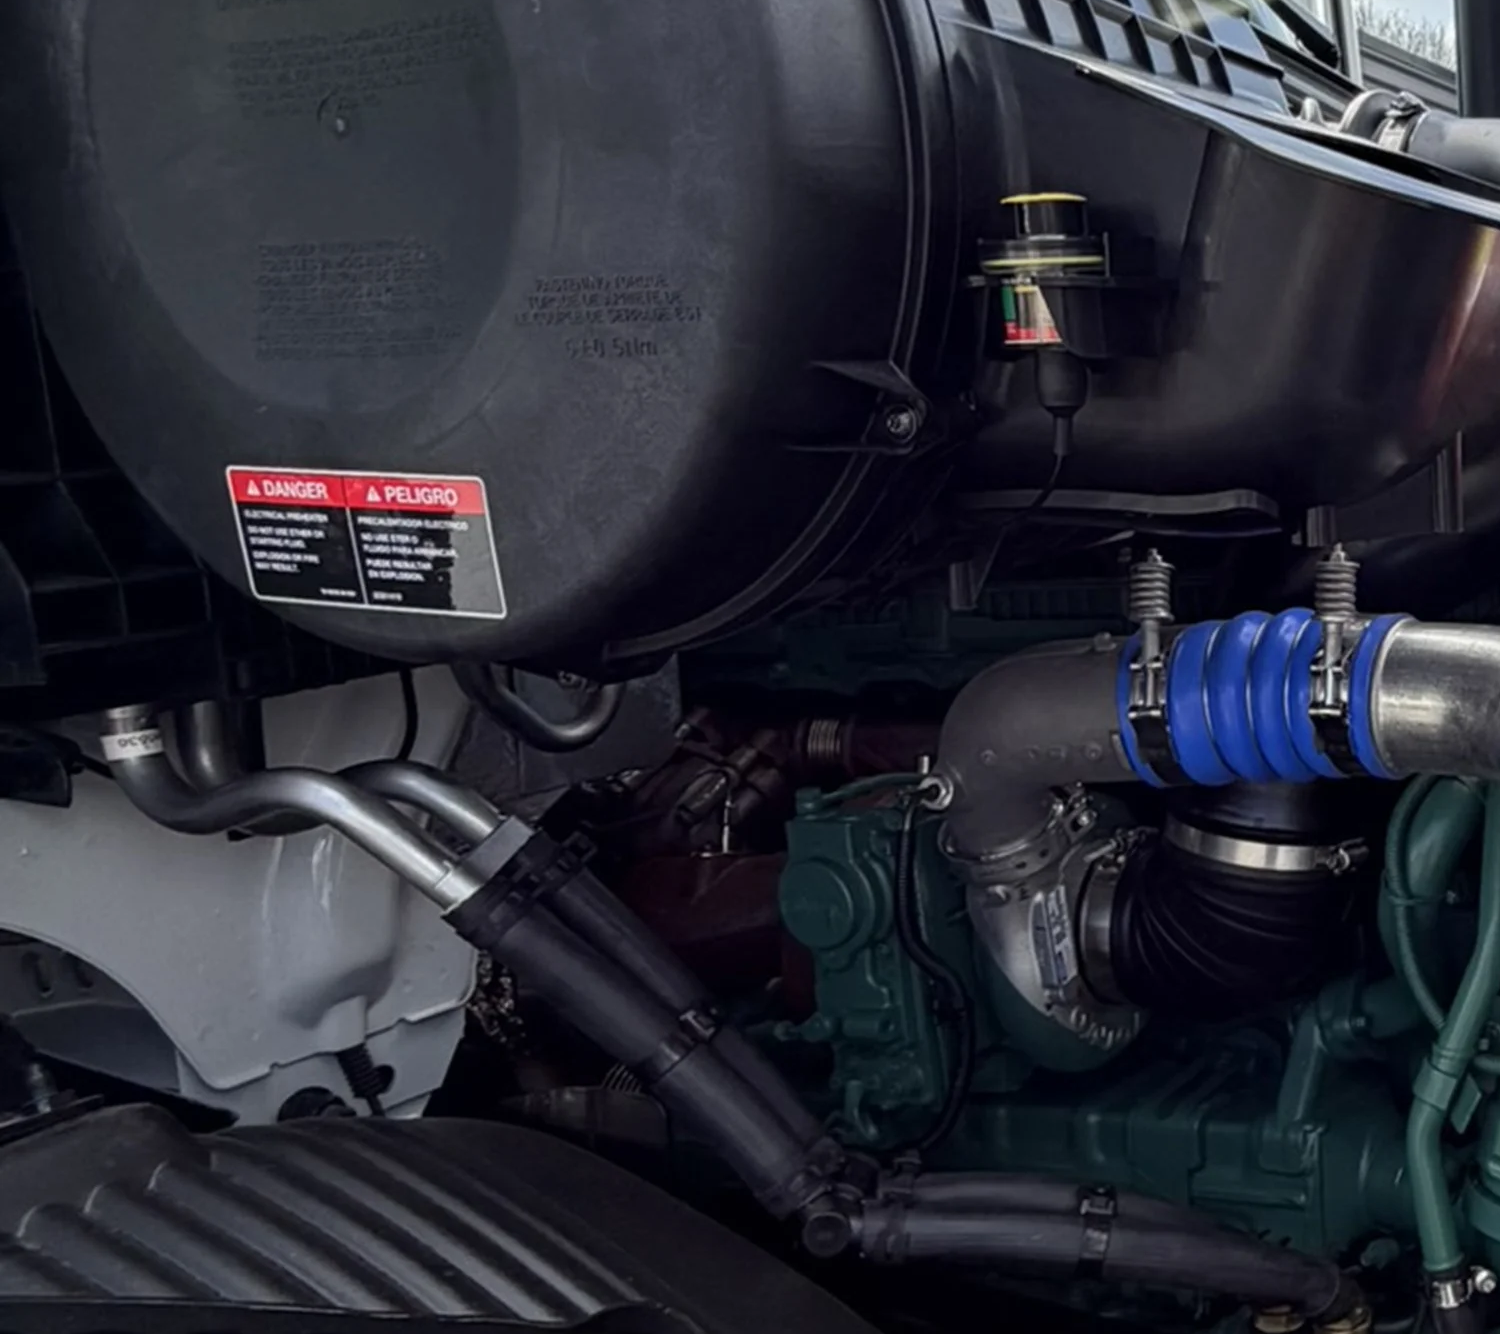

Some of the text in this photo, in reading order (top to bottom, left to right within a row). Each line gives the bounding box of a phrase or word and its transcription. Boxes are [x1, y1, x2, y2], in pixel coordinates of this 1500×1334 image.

[262, 480, 328, 500] DANGER
[384, 486, 459, 507] PELIGRO
[244, 509, 285, 521] ELECTRICAL
[260, 526, 274, 535] NOT
[289, 527, 312, 538] ETHER
[360, 532, 373, 541] NO
[375, 533, 389, 543] USE
[393, 545, 412, 556] PARA
[365, 558, 391, 569] PUEDE
